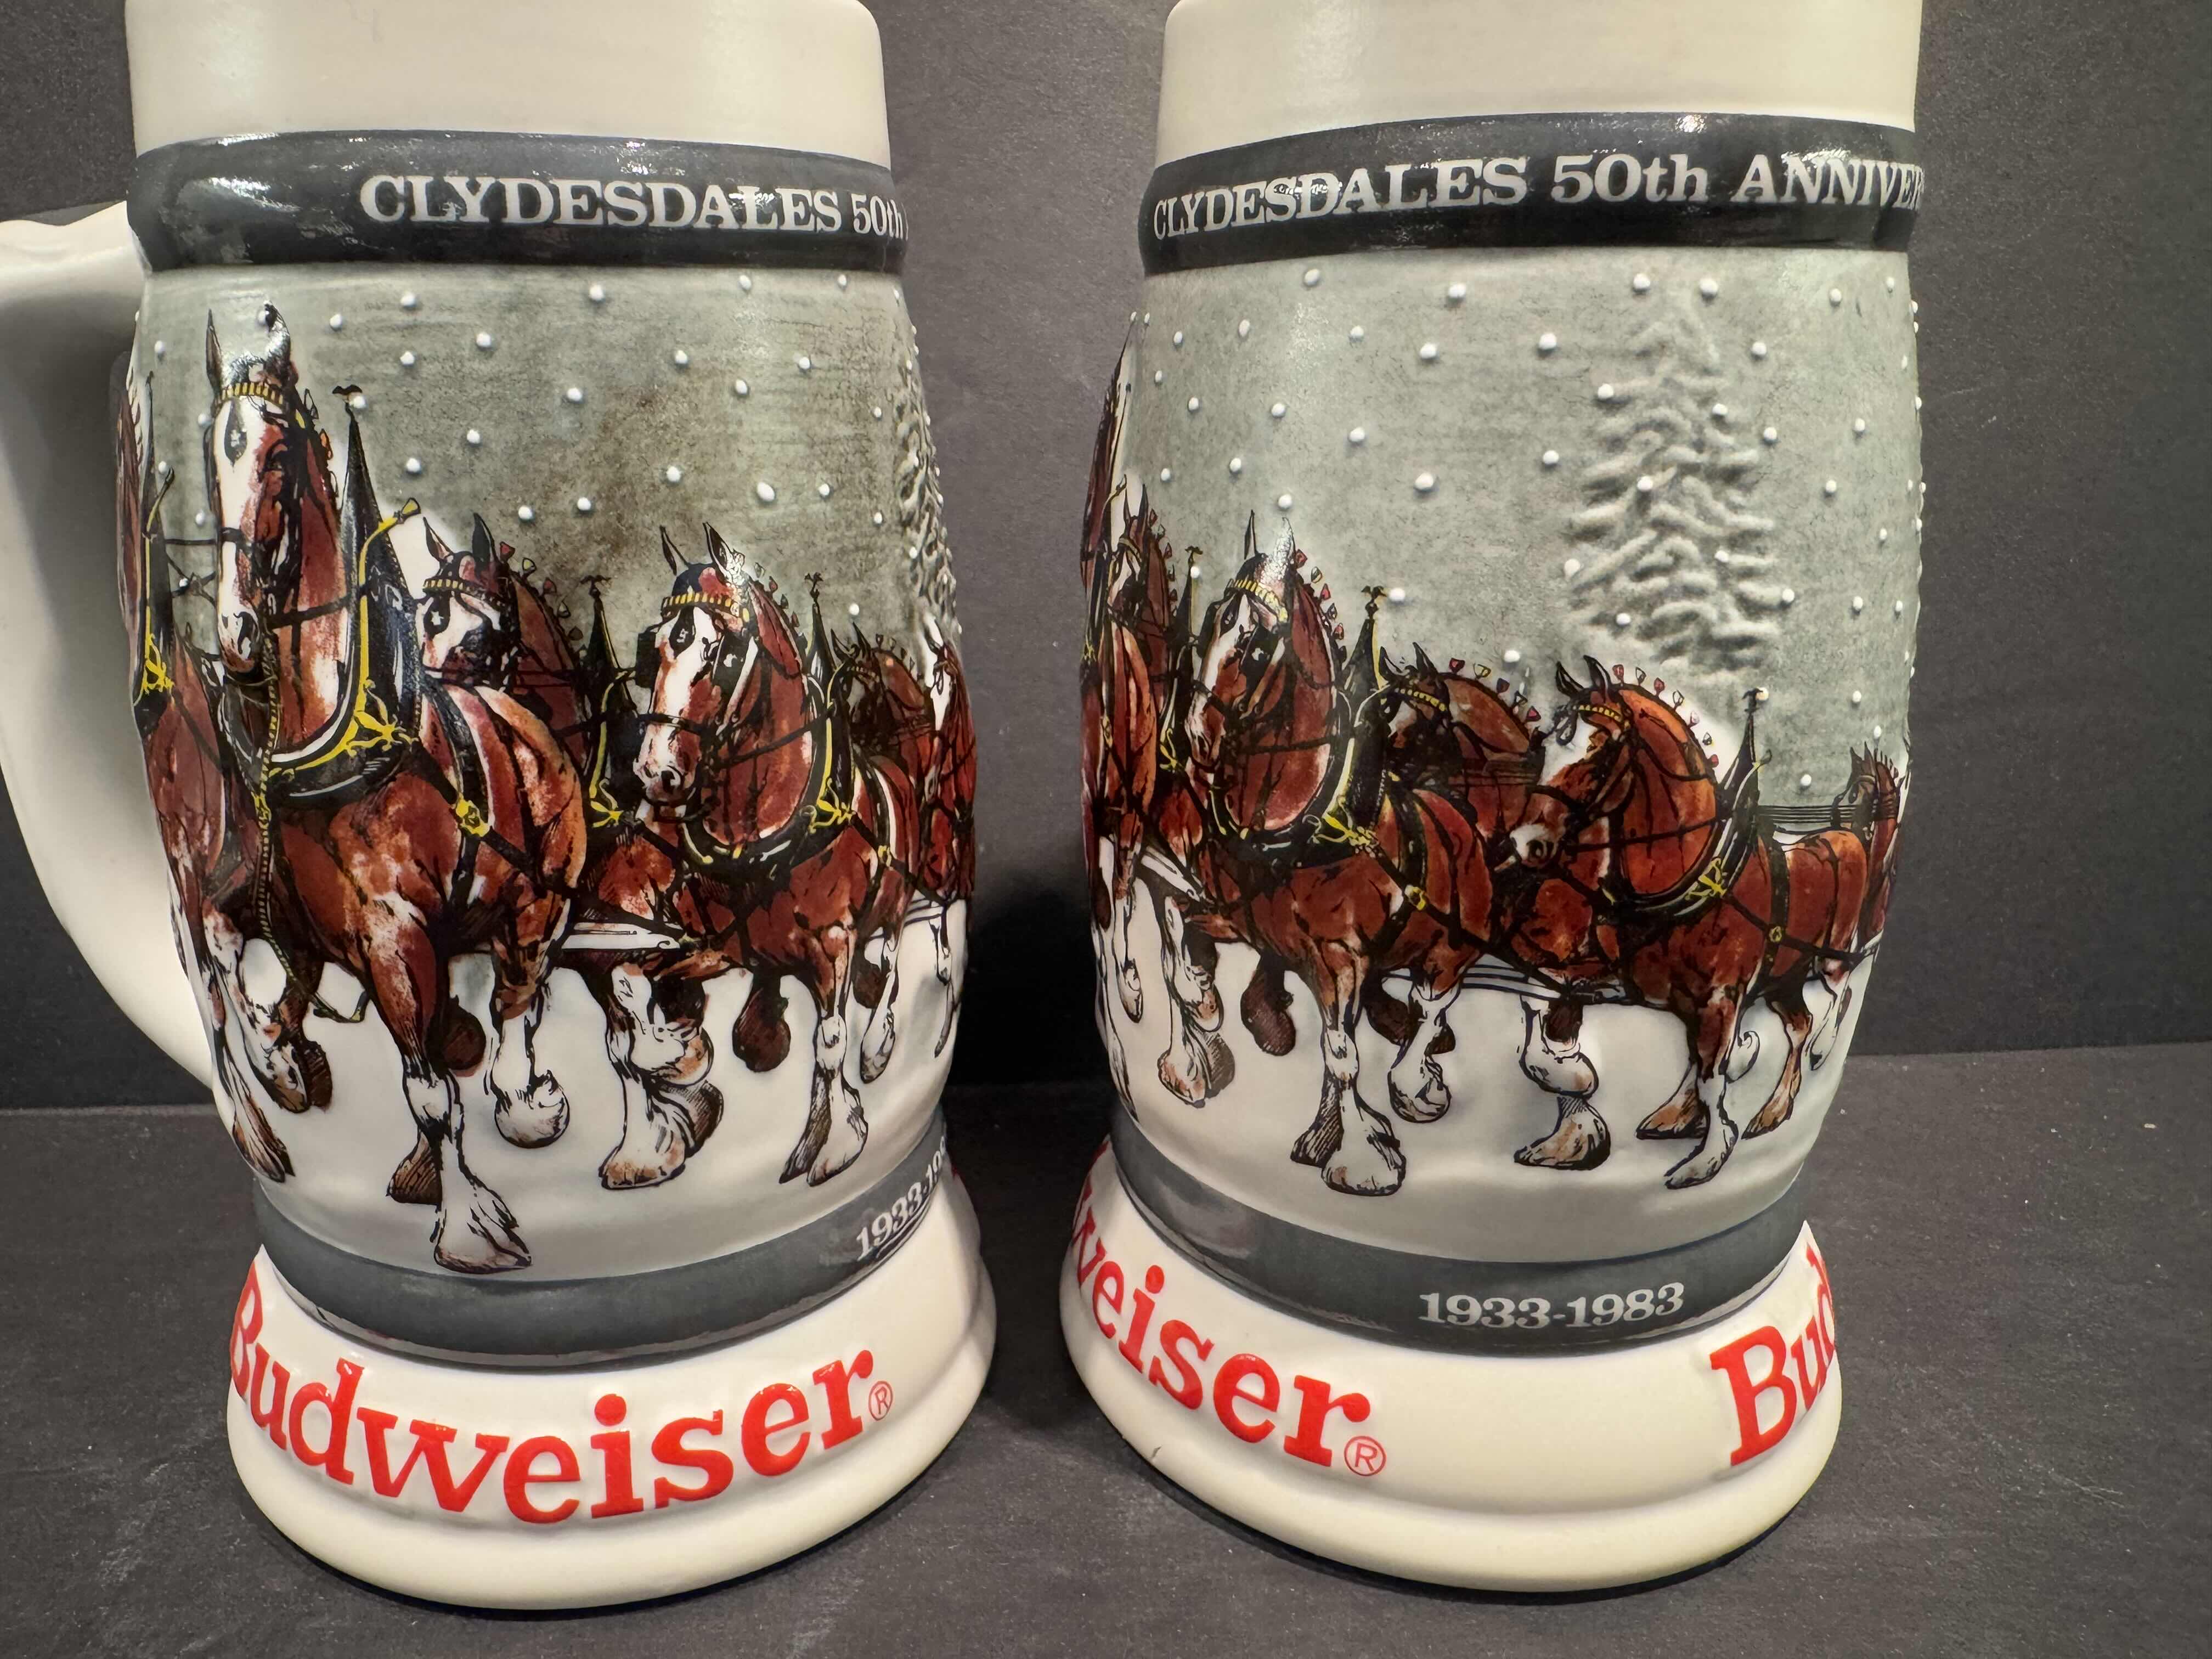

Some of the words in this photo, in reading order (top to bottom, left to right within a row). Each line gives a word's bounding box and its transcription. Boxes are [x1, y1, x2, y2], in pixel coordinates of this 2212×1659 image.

[360, 175, 842, 232] CLYDESDALES
[850, 193, 904, 240] 50th
[1154, 157, 1527, 240] CLYDESDALES
[1550, 153, 1710, 204] 50th
[1418, 1282, 1685, 1329] 1933-1983
